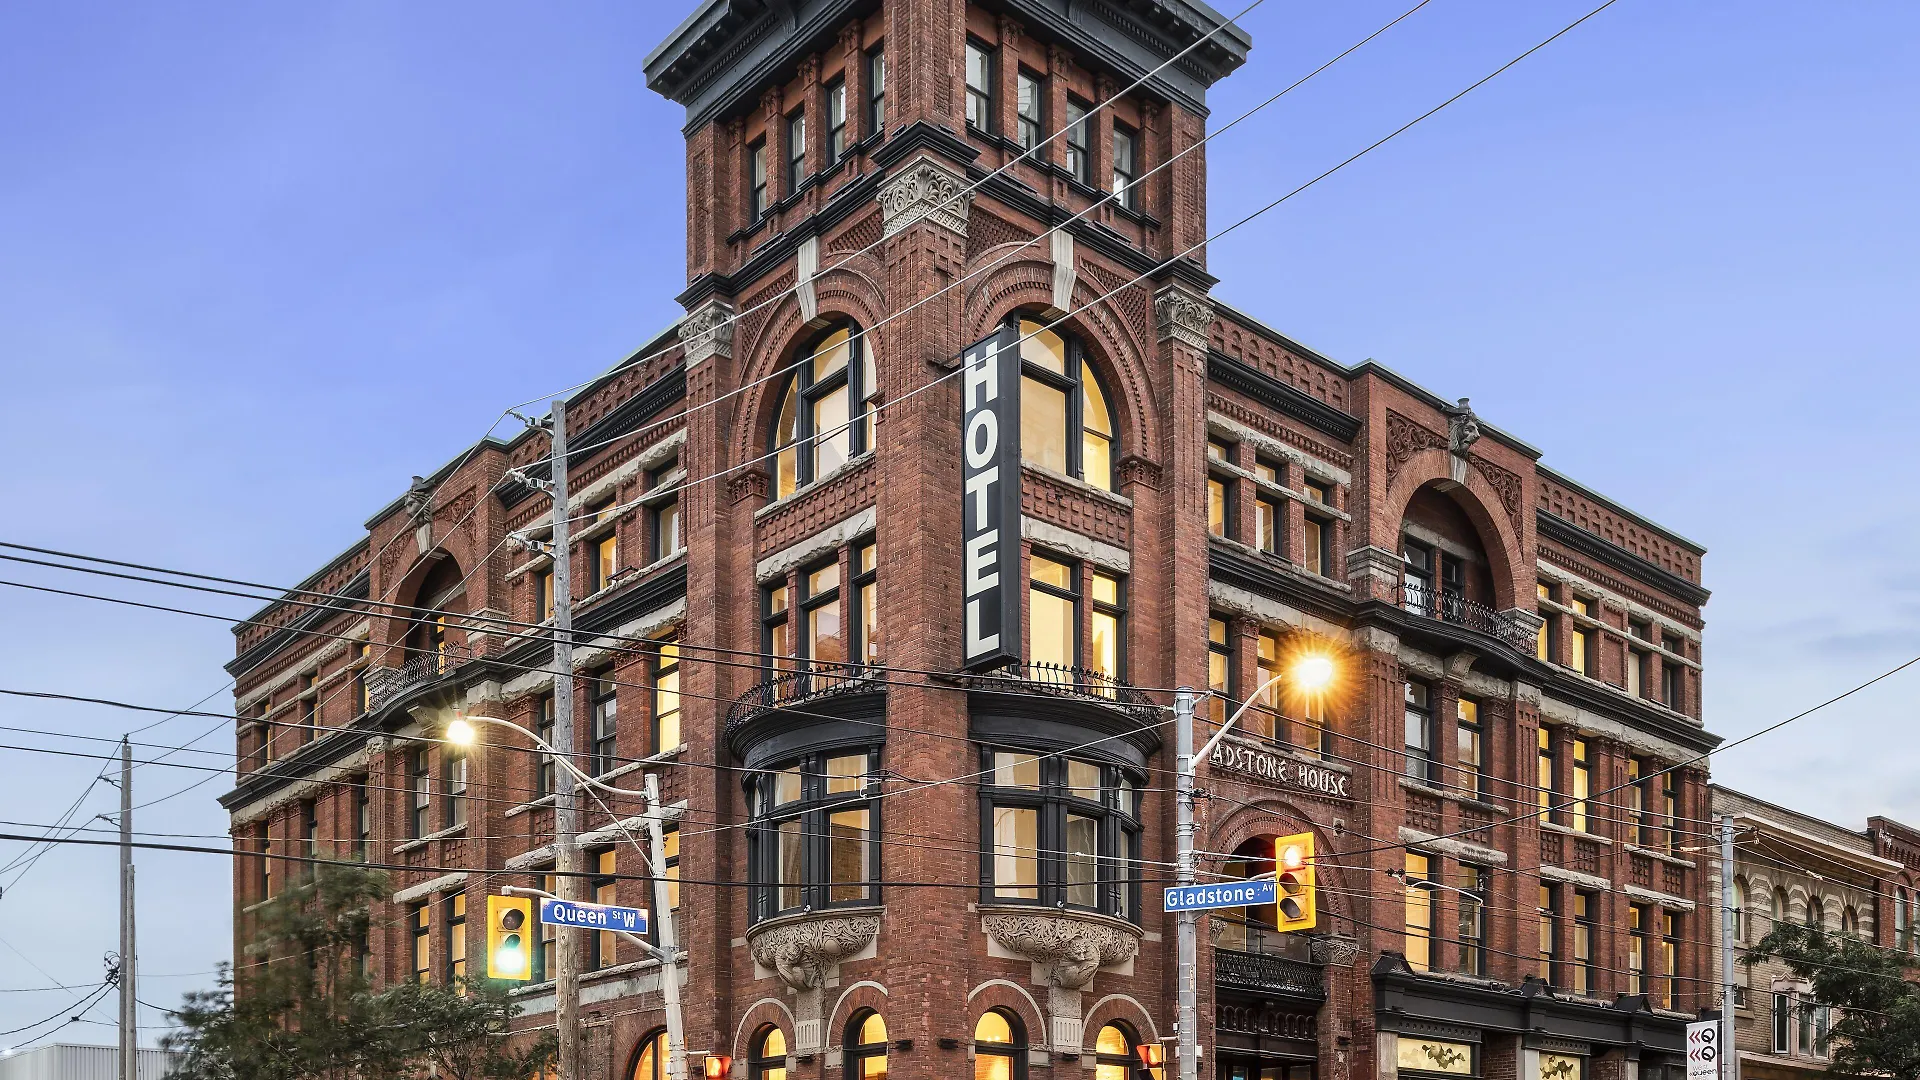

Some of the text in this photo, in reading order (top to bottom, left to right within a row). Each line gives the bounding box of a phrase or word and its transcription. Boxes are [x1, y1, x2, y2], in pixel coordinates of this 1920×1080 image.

[966, 341, 1000, 660] HOTEL
[1299, 763, 1348, 797] HOUSE
[1166, 883, 1274, 907] Gladstone Av
[553, 904, 636, 928] Queen St W
